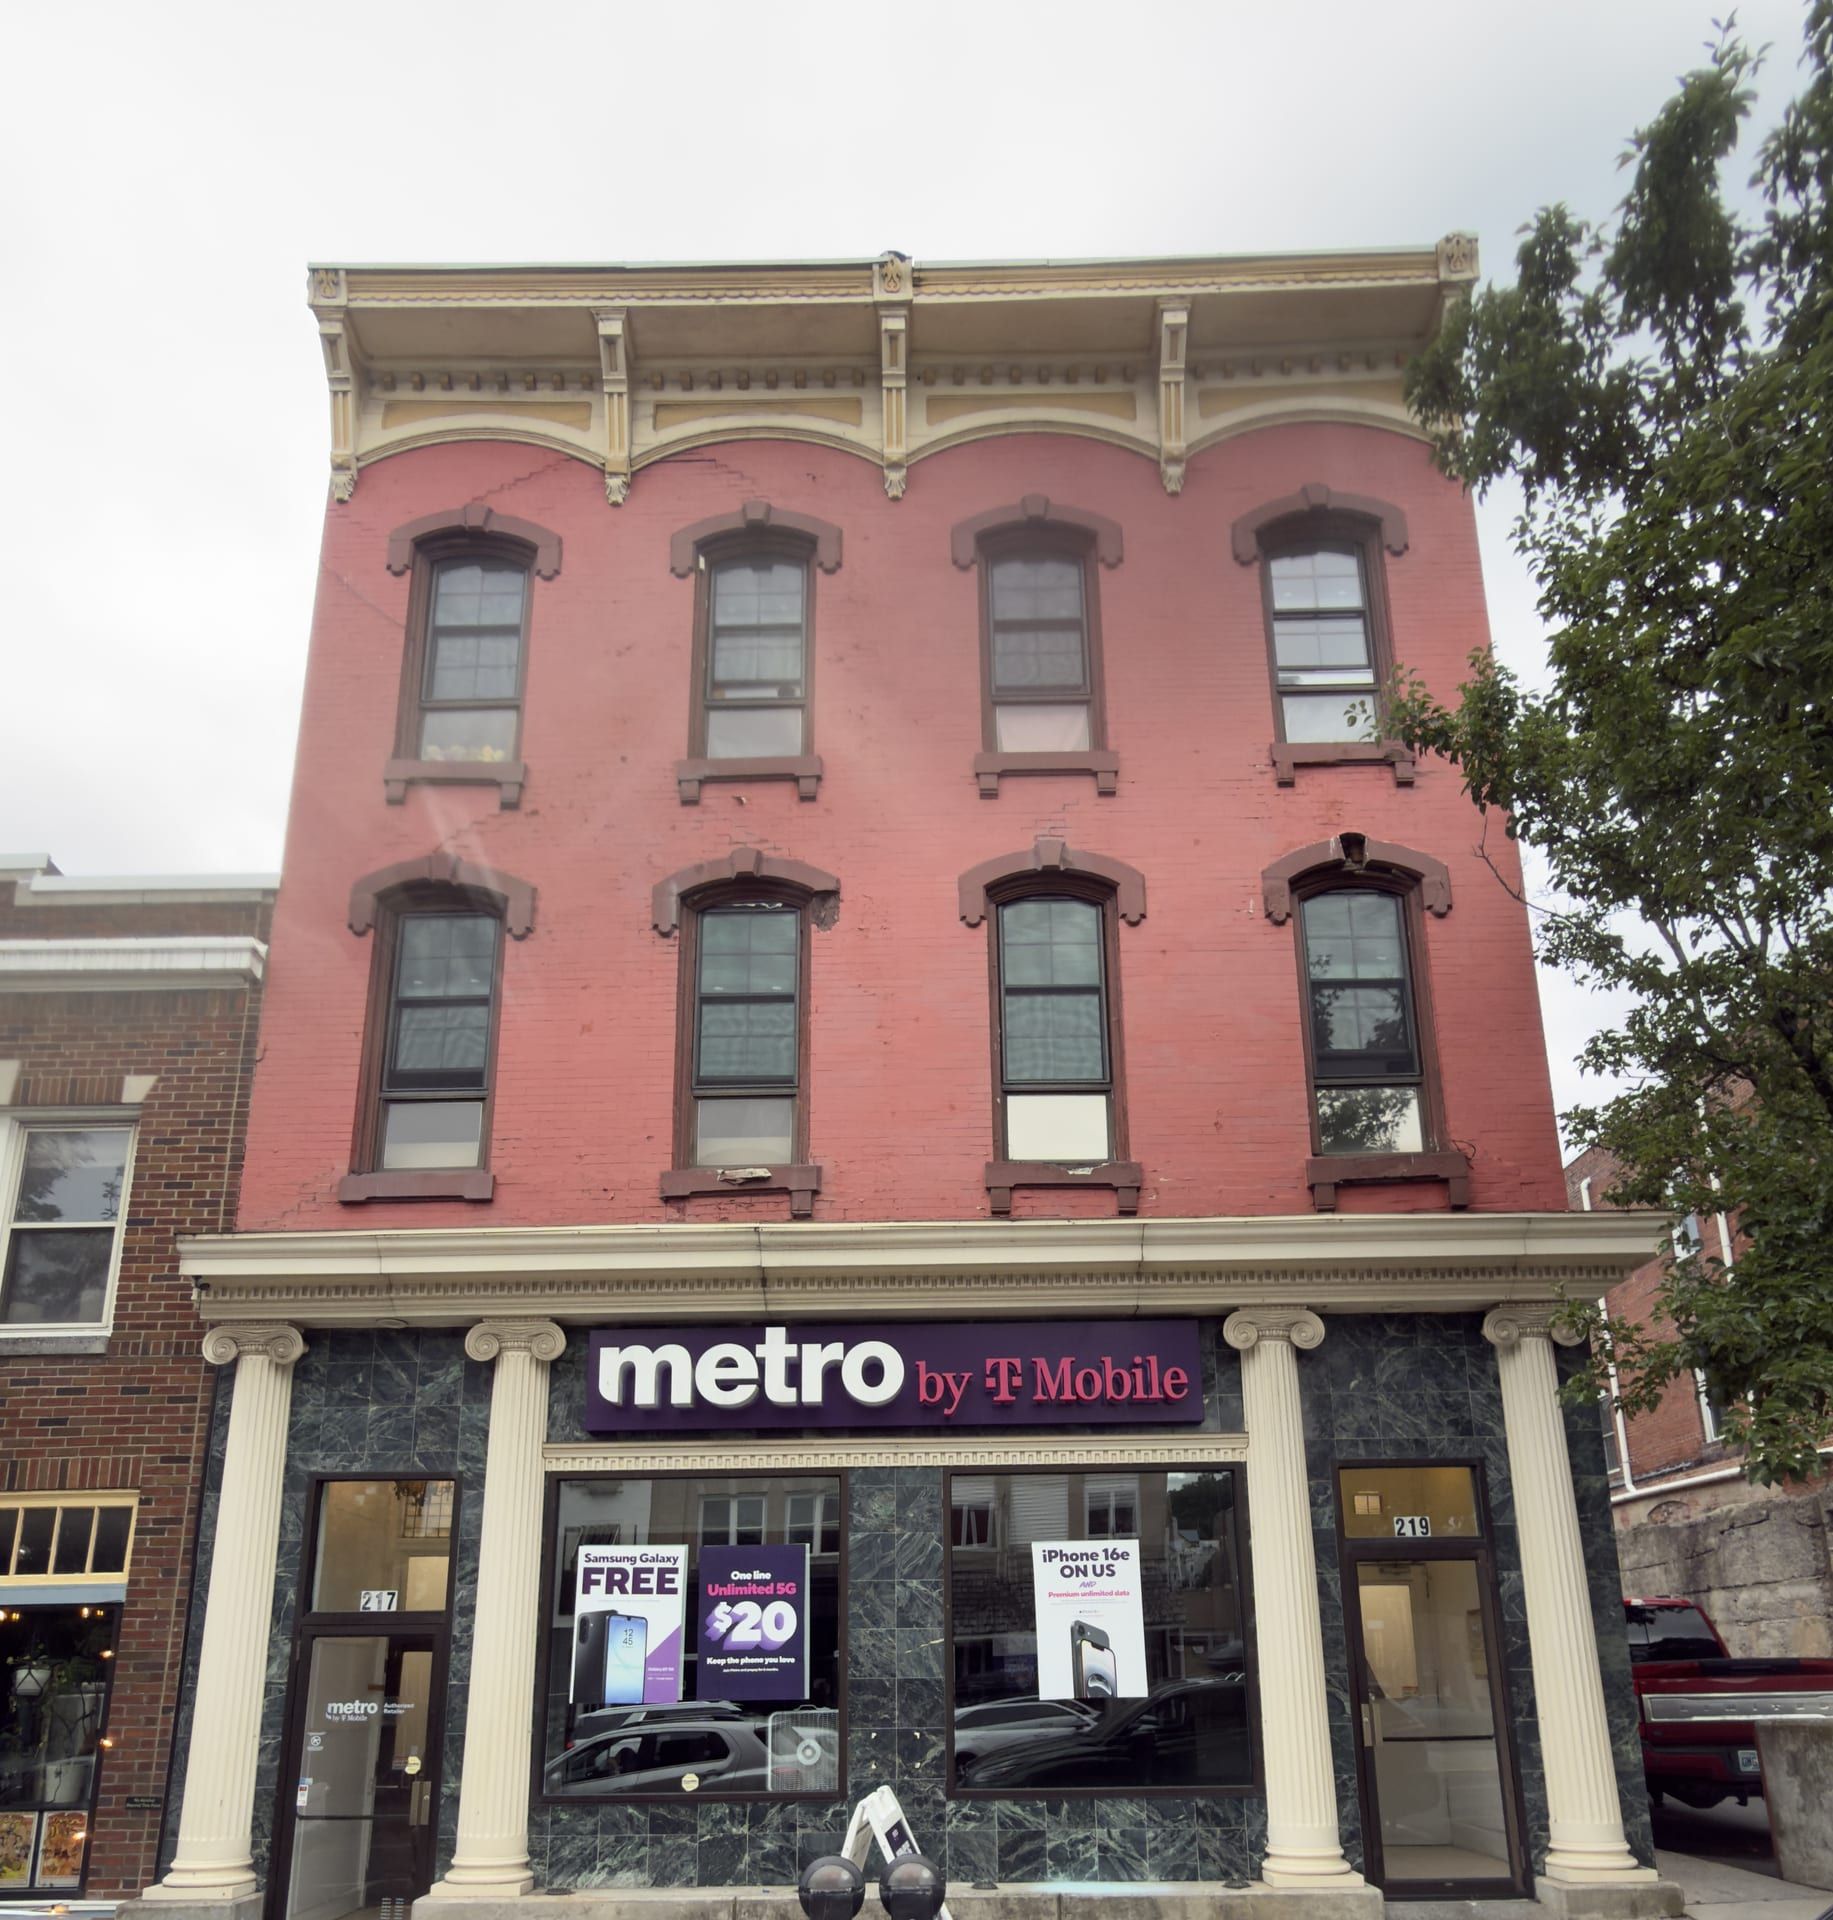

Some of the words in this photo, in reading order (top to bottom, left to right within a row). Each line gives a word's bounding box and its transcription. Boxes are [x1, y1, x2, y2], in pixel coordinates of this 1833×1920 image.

[598, 1327, 905, 1404] metro
[915, 1361, 973, 1415] by
[1032, 1355, 1189, 1401] Mobile
[1395, 1517, 1429, 1536] 219
[584, 1553, 637, 1565] Samsung
[639, 1553, 679, 1565] Galaxy
[1042, 1549, 1100, 1563] iPhone
[1102, 1548, 1130, 1561] 16e
[731, 1571, 752, 1580] One
[753, 1570, 771, 1580] line
[1060, 1564, 1088, 1578] ON
[1092, 1563, 1116, 1577] US
[582, 1567, 679, 1595] FREE
[707, 1582, 774, 1596] Unlimited
[776, 1582, 796, 1595] 5G
[362, 1592, 396, 1610] 217
[711, 1601, 797, 1642] $20
[622, 1638, 633, 1646] 45
[706, 1657, 726, 1666] Keep
[727, 1656, 739, 1664] the
[740, 1656, 764, 1665] phone
[764, 1657, 779, 1665] you
[779, 1655, 795, 1663] love
[327, 1700, 378, 1714] metro
